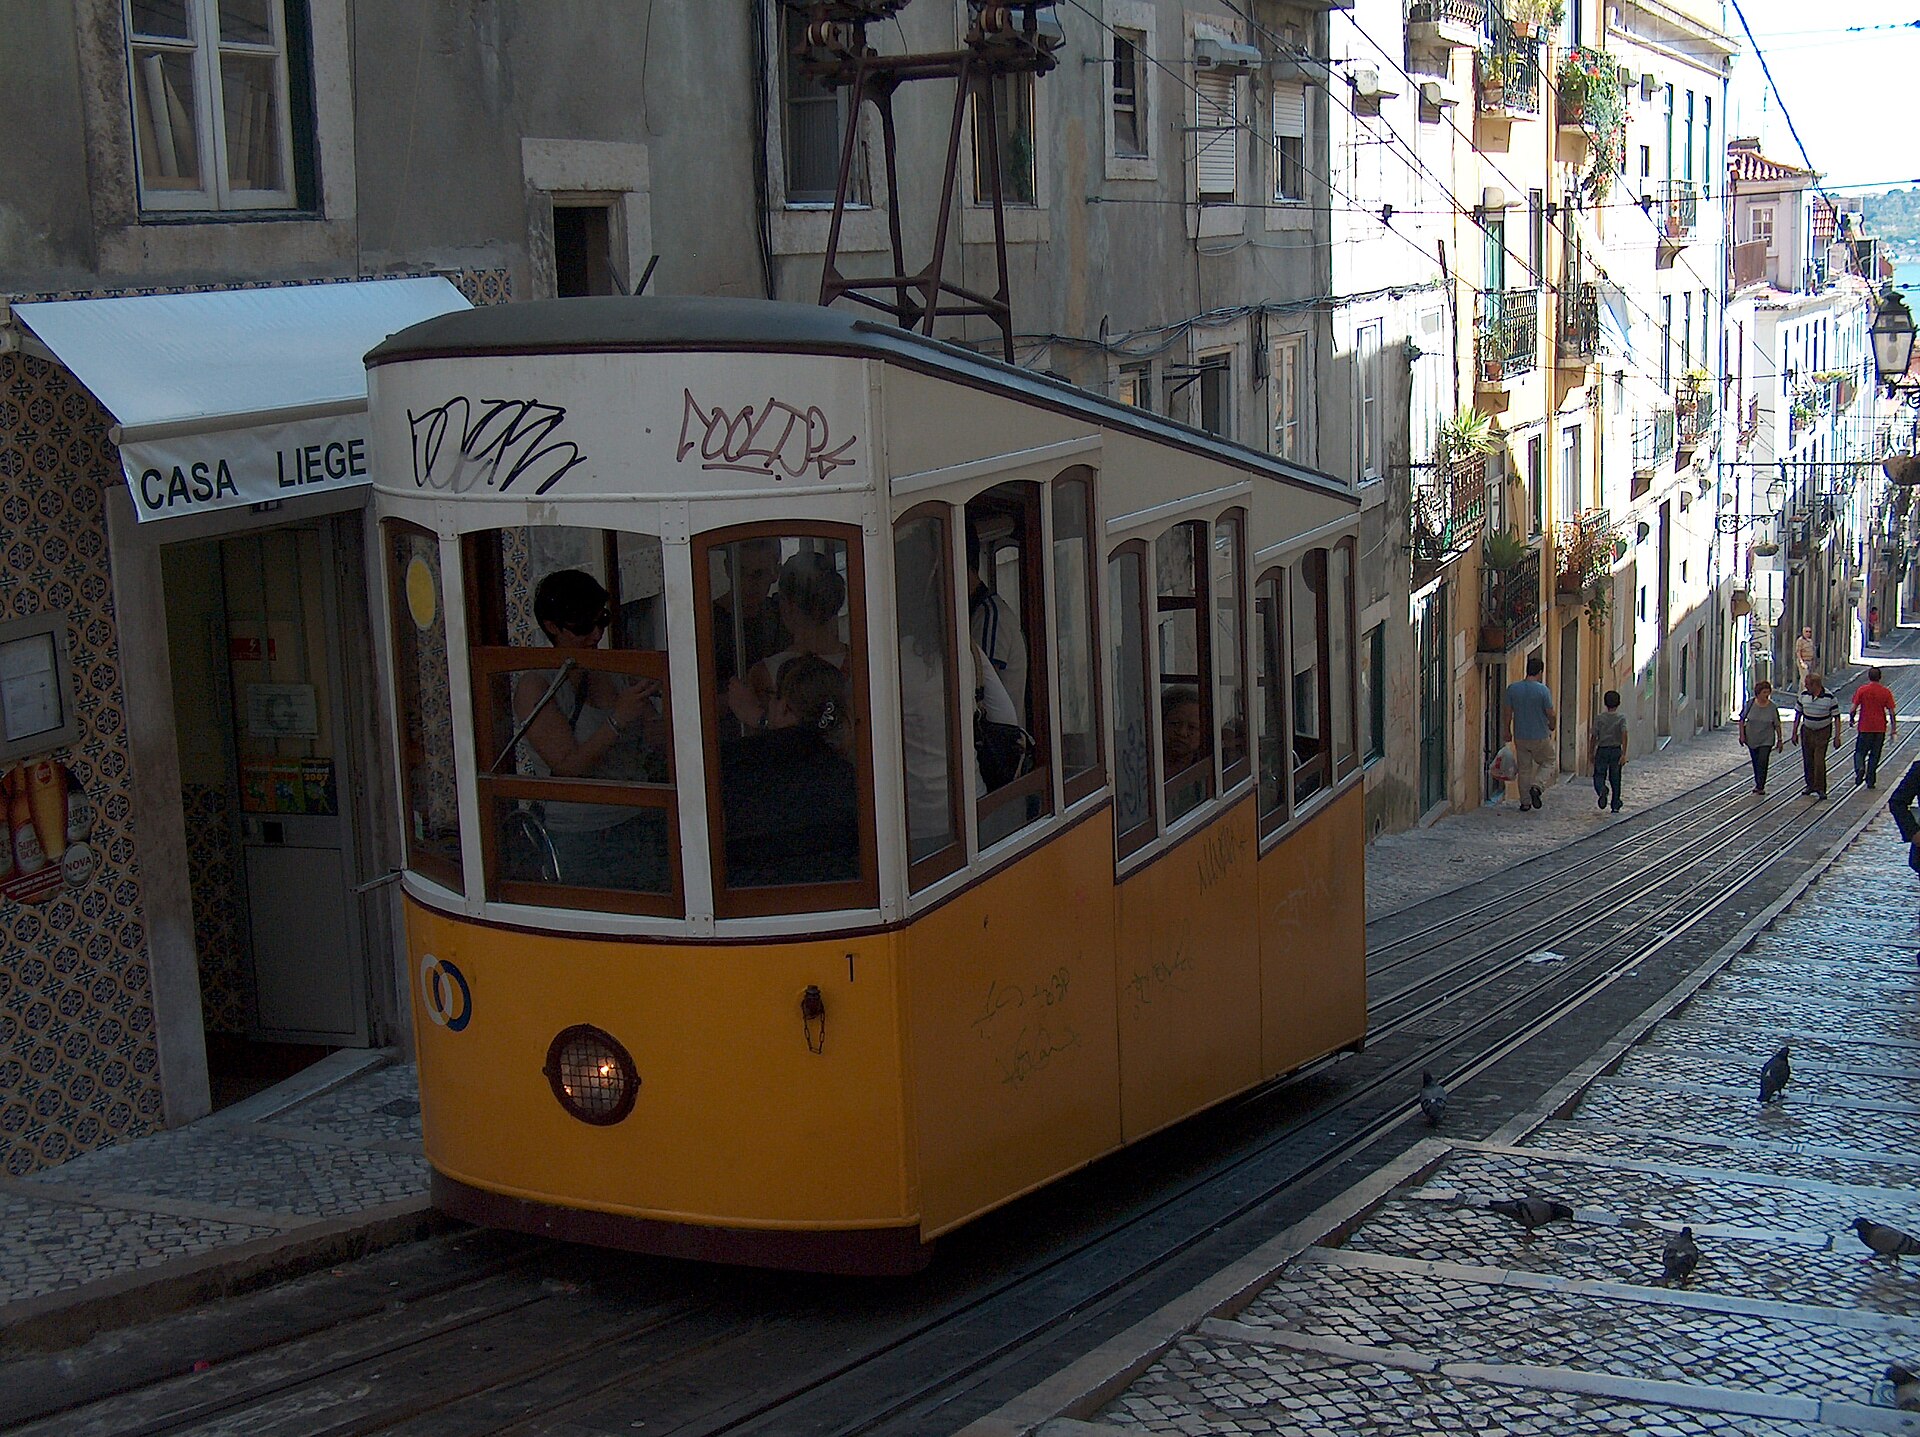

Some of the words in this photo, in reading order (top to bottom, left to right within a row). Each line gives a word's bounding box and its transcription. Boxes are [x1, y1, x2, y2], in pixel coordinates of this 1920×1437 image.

[141, 459, 239, 510] CASA
[277, 438, 367, 488] LIEGE
[303, 773, 329, 781] 2007
[65, 855, 92, 872] NOVA
[845, 953, 854, 983] 1
